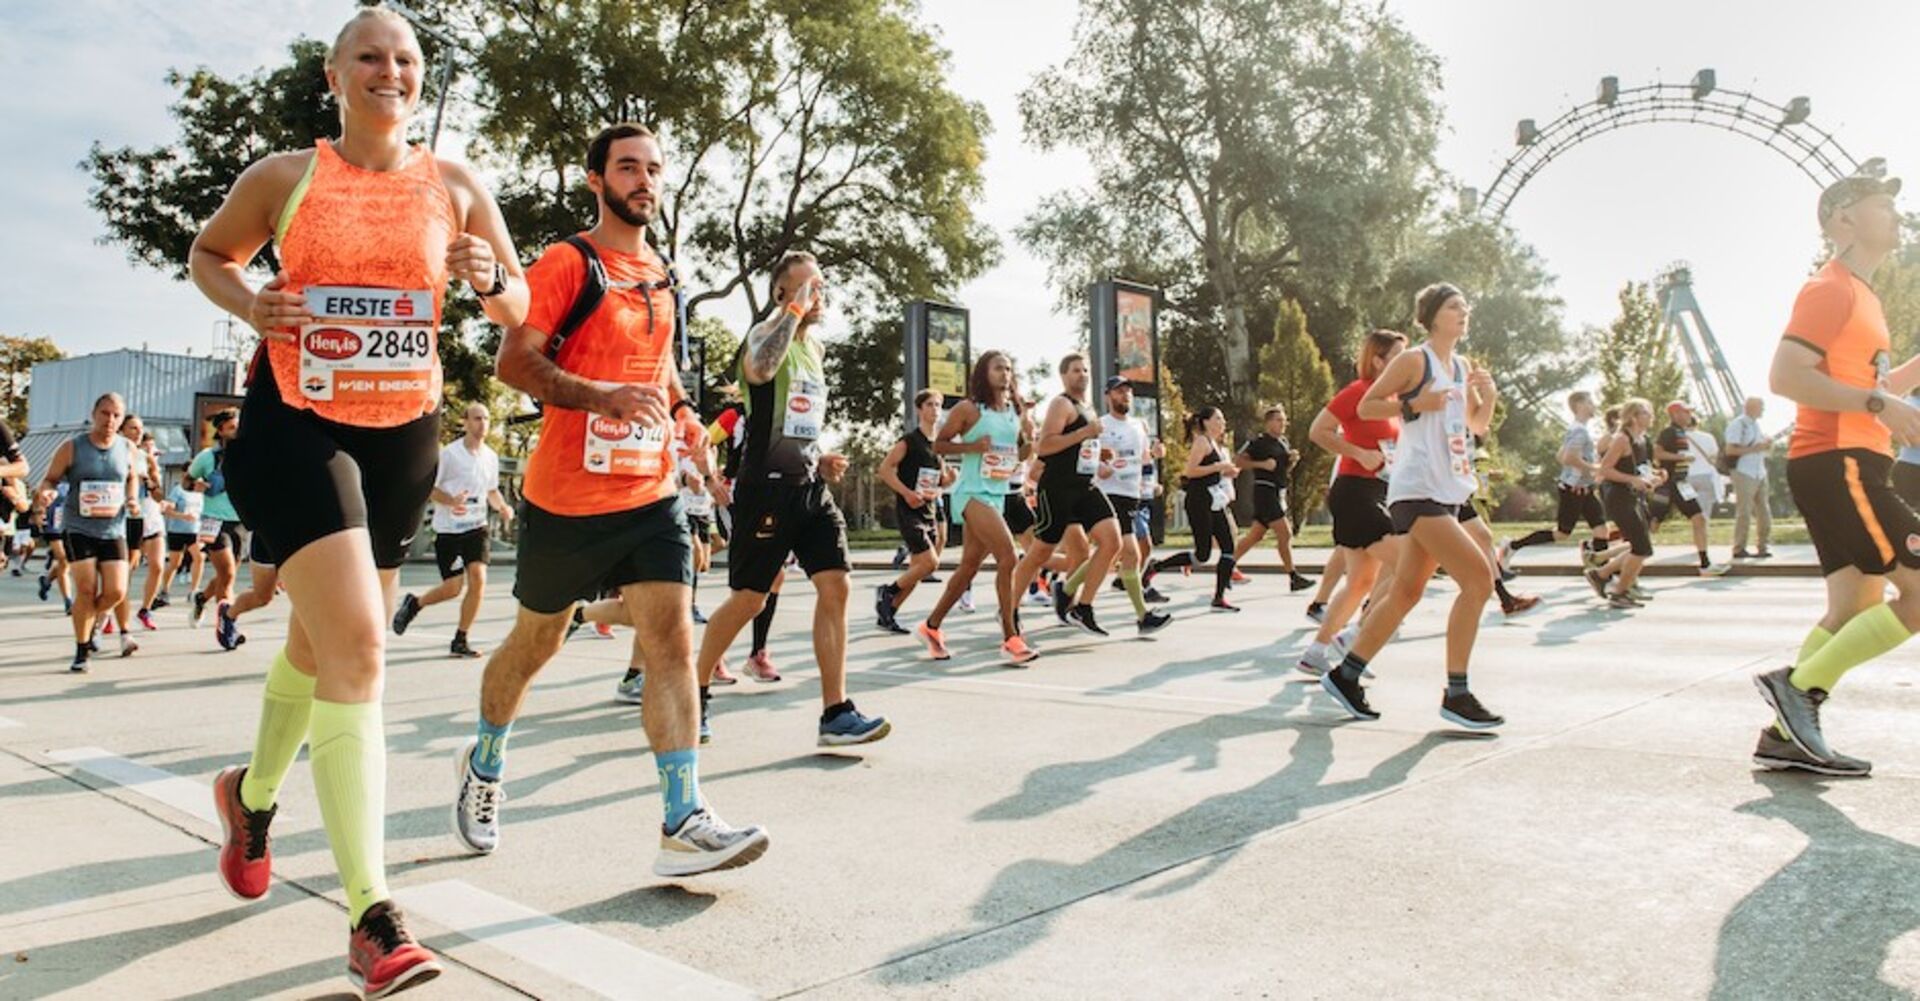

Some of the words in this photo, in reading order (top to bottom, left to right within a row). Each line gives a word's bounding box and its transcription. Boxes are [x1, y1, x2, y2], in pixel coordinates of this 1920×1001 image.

[325, 297, 392, 317] ERSTE
[309, 334, 359, 354] Hervis
[366, 330, 430, 359] 2849
[338, 379, 375, 392] WIEN
